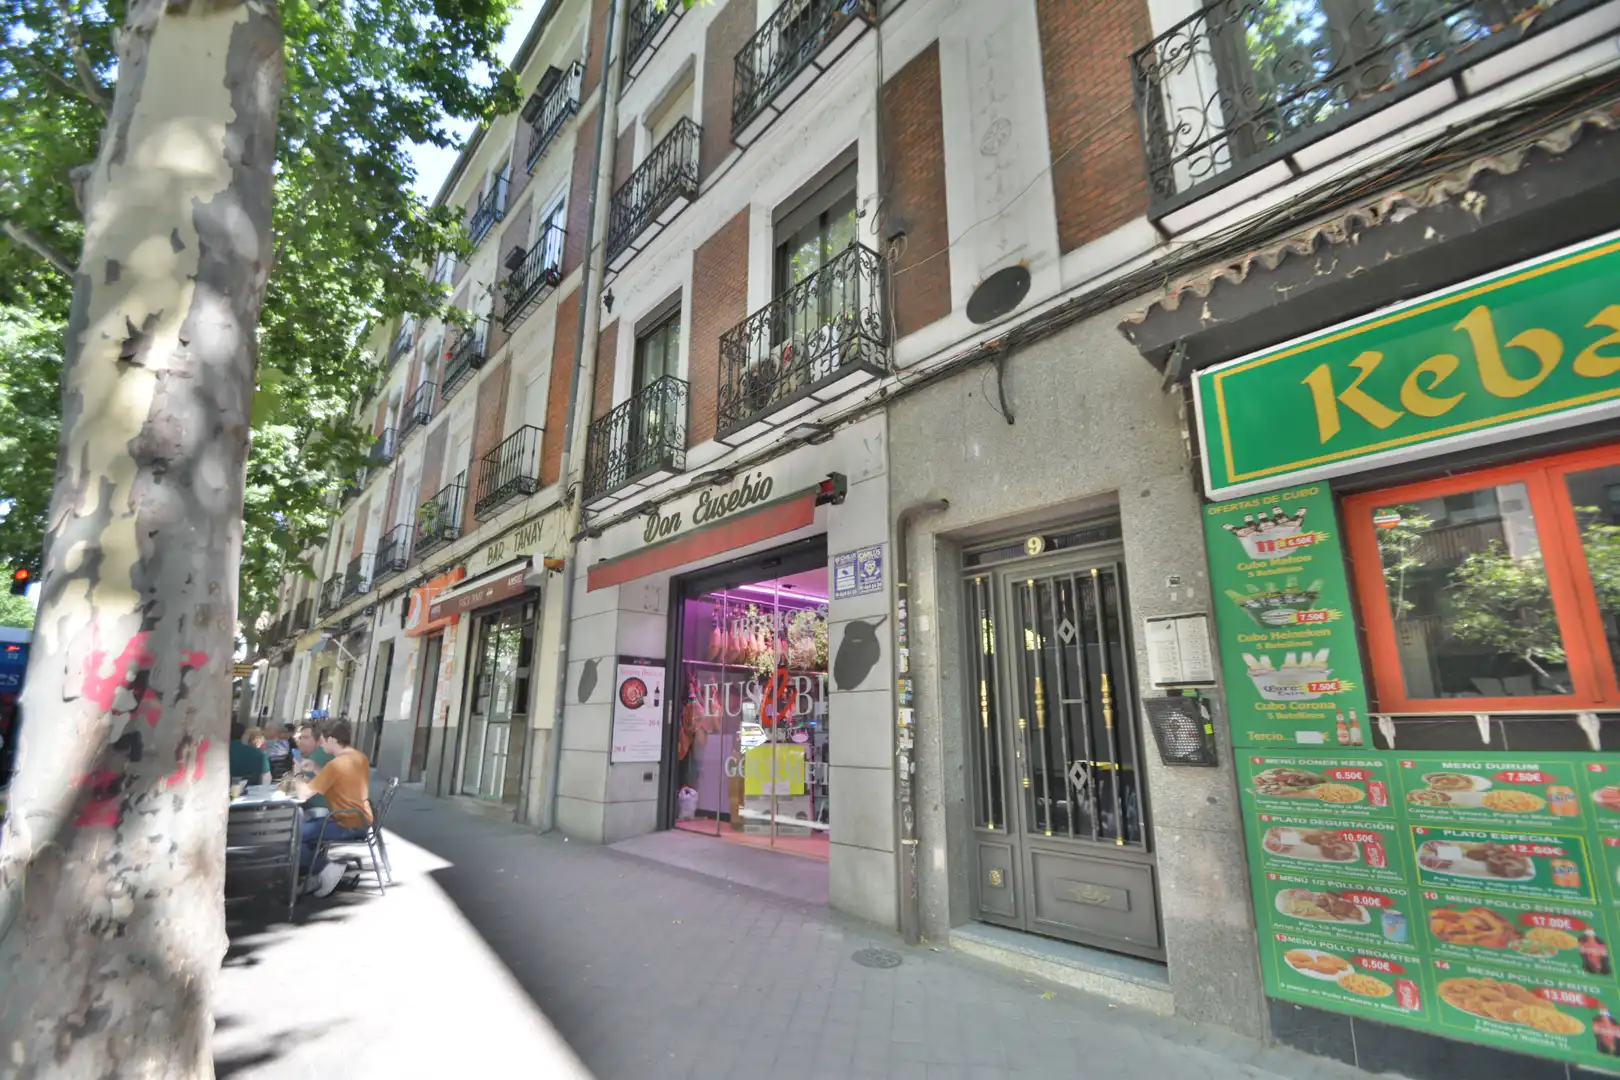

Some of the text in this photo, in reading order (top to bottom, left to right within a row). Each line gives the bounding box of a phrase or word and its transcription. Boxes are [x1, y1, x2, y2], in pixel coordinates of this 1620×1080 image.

[643, 472, 774, 543] Don Eusebio
[1207, 487, 1320, 515] OFERTAS DE CUBO
[487, 519, 545, 566] BAR TANAY
[1028, 536, 1042, 555] 9
[1236, 561, 1268, 571] Cubo
[1237, 634, 1268, 642] Cubo
[1255, 702, 1337, 710] Cubo Corona
[1298, 758, 1339, 766] DONER
[1485, 762, 1540, 771] DURUM
[1336, 771, 1363, 780] 6.50€
[1271, 815, 1307, 824] PLATO
[1443, 829, 1489, 839] PLATO
[1491, 831, 1564, 844] ESPECIAL
[1327, 880, 1364, 890] POLLO
[1367, 885, 1407, 896] ASADO
[1423, 892, 1438, 901] 10
[1484, 897, 1531, 911] POLLO
[1535, 904, 1594, 918] ENTERO
[1275, 934, 1287, 943] 13
[1320, 941, 1355, 953] POLLO
[1357, 948, 1421, 964] BROASTER
[1508, 971, 1555, 986] POLLO
[1558, 981, 1601, 994] FRITO
